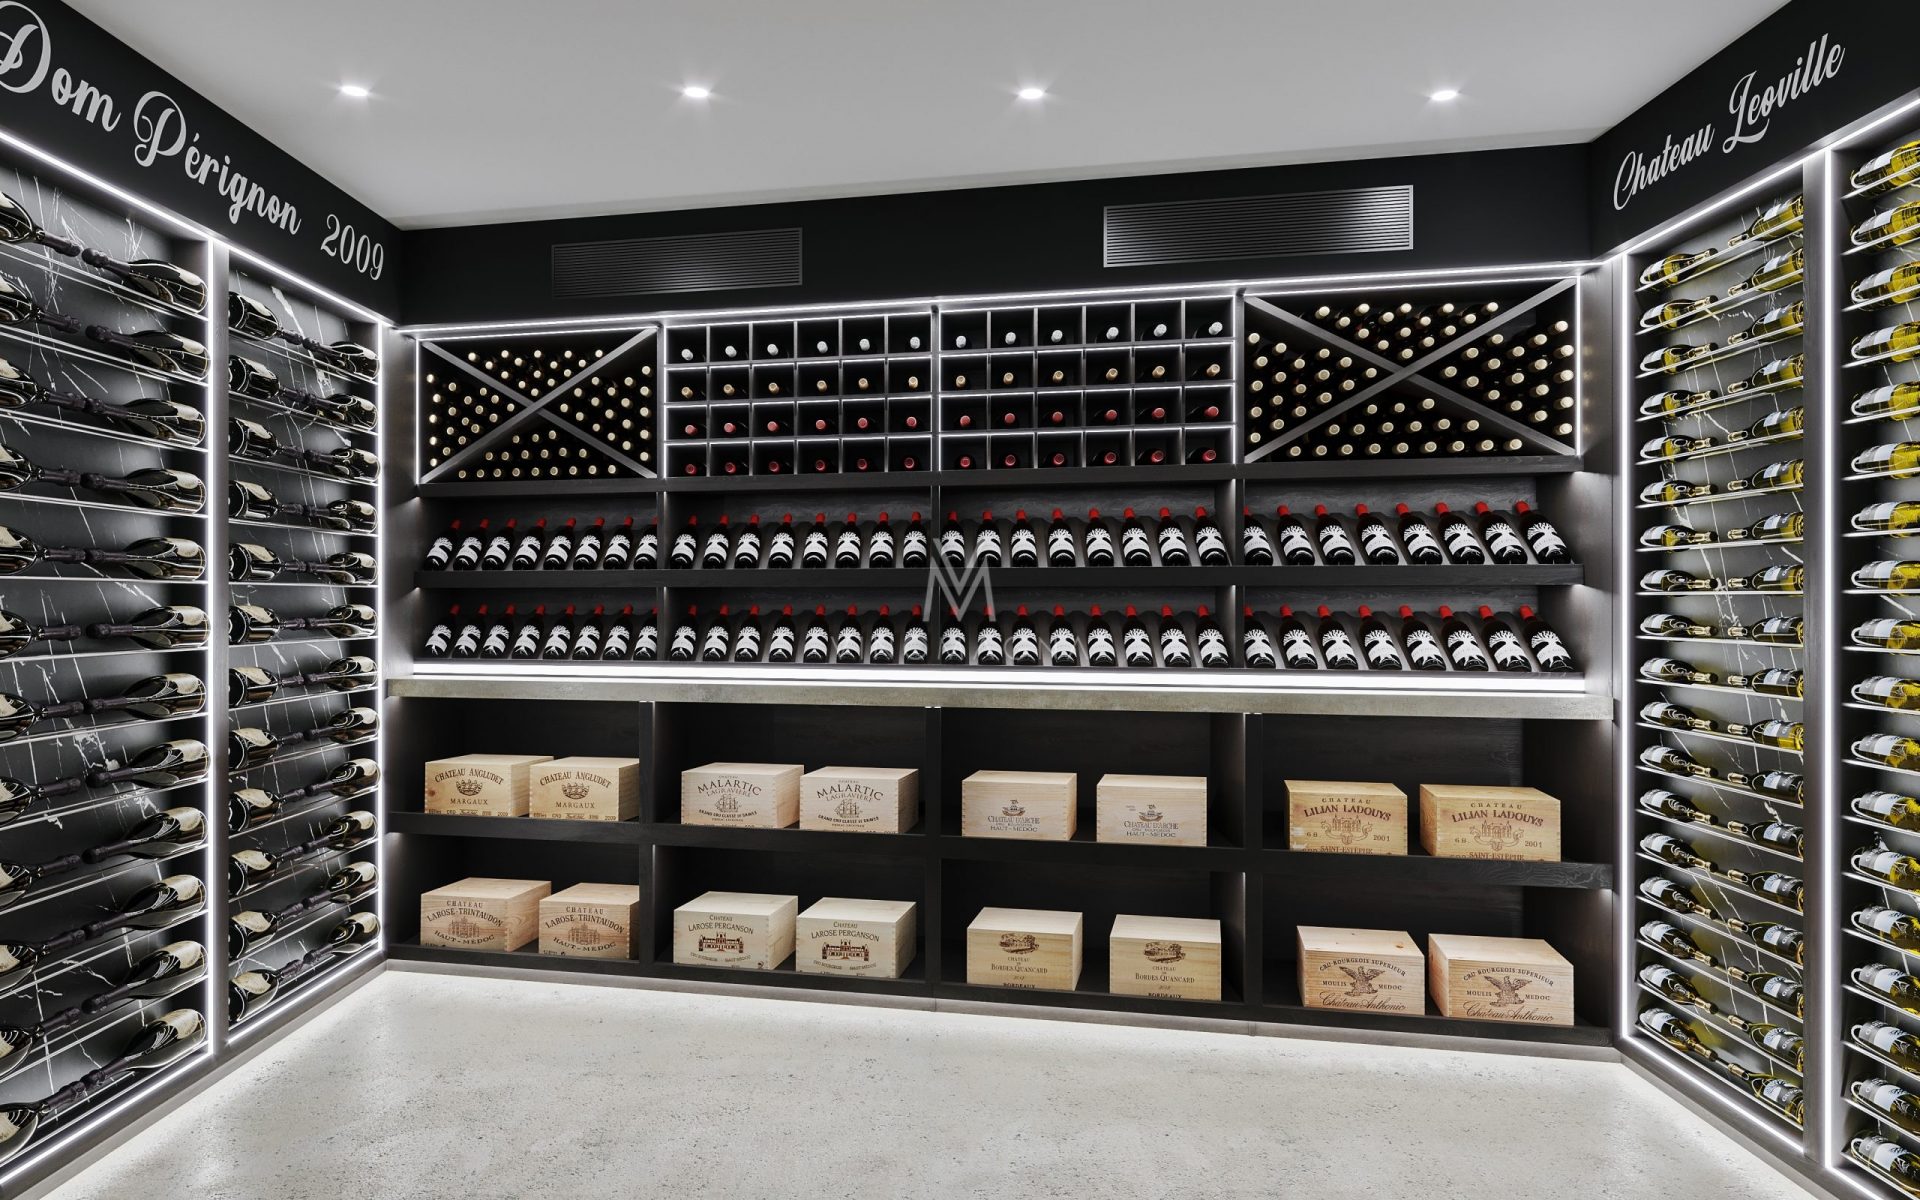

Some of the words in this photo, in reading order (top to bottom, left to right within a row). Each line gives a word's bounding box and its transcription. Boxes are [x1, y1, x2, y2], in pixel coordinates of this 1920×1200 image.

[1612, 123, 1716, 211] Chateau
[1721, 32, 1846, 154] Leoville
[0, 0, 121, 132] Dom
[133, 90, 302, 235] Pérignon
[319, 213, 385, 281] 2009
[434, 767, 466, 783] CHATEAU
[469, 767, 505, 785] ANGLUDET
[540, 771, 572, 786] CHATEAU
[576, 770, 612, 789] ANGLUDET
[697, 780, 762, 796] MALARTIC
[816, 784, 884, 801] MALARTIC
[1304, 804, 1339, 818] LILIAN
[1343, 804, 1392, 822] LADOUYS
[1452, 810, 1488, 823] LILIAN
[1493, 810, 1544, 828] LADOUYS
[446, 900, 483, 909] CHATEAU
[566, 906, 604, 914] CHATEAU
[688, 922, 714, 932] LAROSE
[714, 922, 754, 934] PERGANSON
[811, 930, 838, 939] LAROSE
[838, 930, 880, 942] PERGANSON
[1333, 958, 1369, 966] BOURGEOIS
[1372, 959, 1406, 977] SUPERIEUR
[1478, 966, 1516, 975] BOURGEOIS
[1517, 968, 1554, 986] SUPERIEUR
